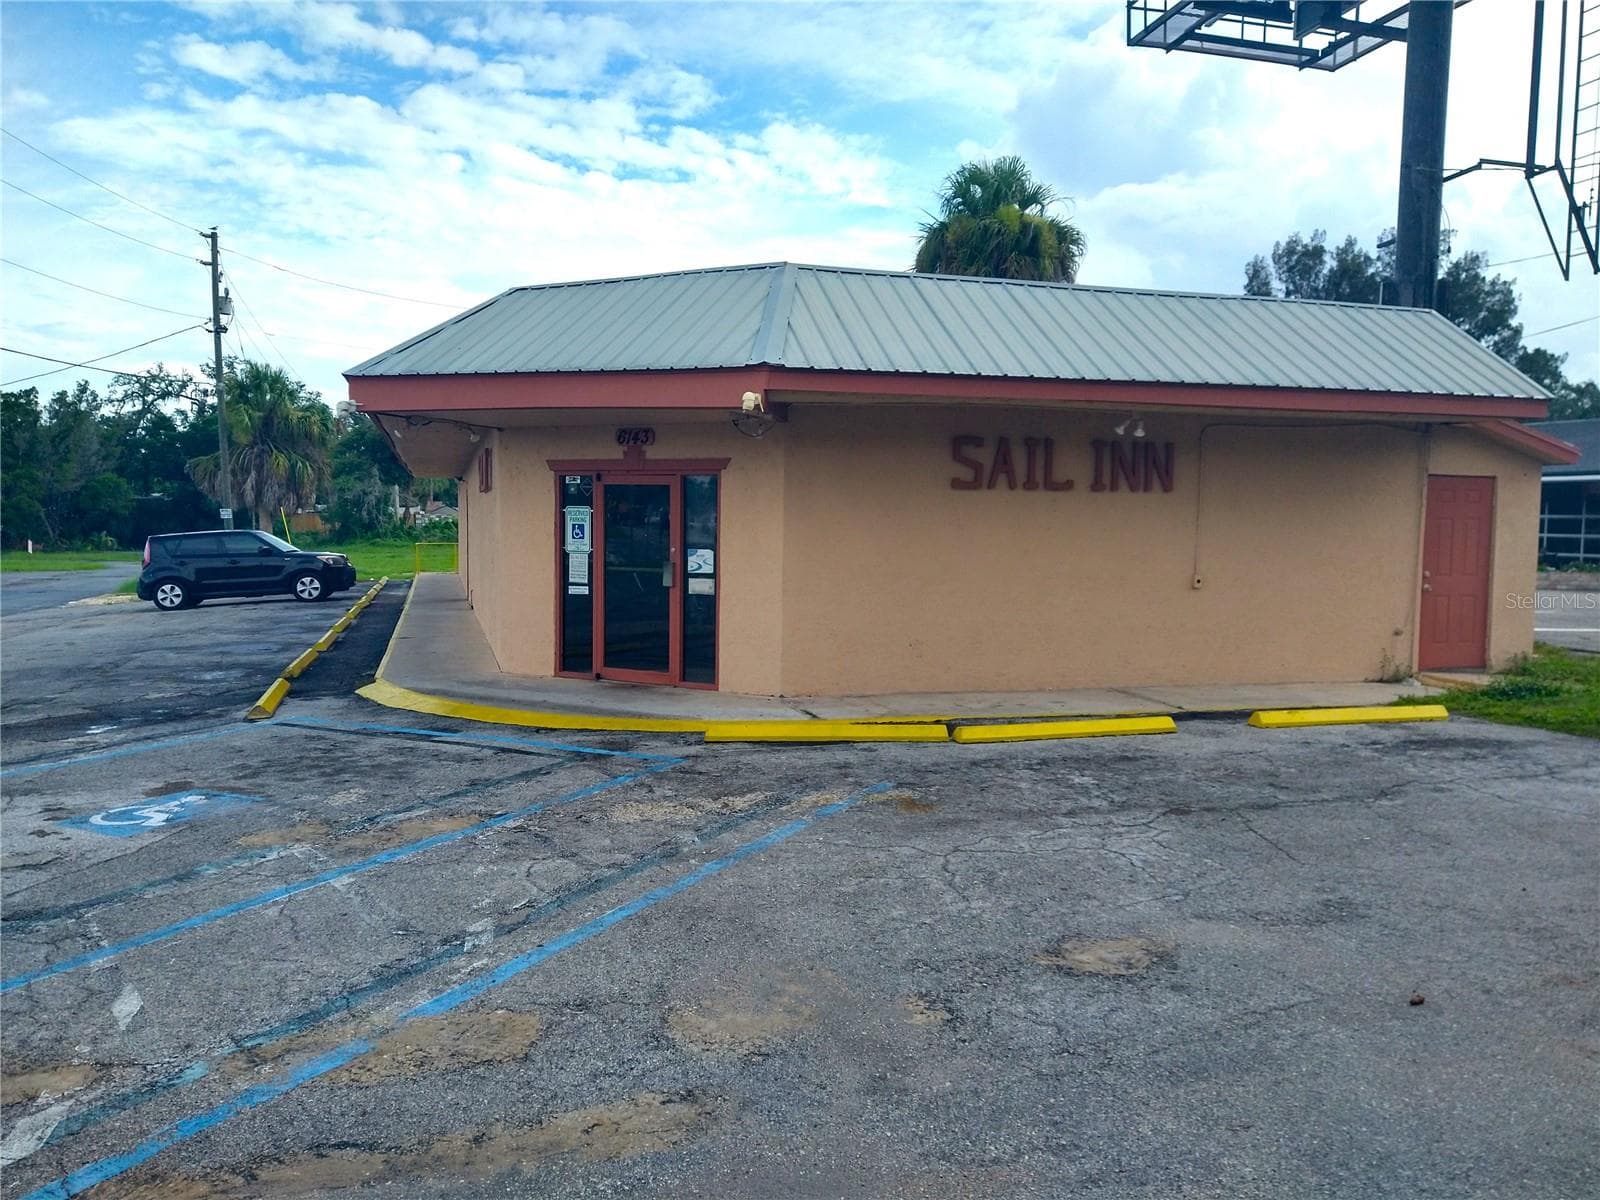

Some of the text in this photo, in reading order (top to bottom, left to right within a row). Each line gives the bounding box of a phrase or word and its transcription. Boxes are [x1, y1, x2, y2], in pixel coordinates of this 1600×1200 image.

[616, 428, 651, 445] 6143
[950, 435, 1175, 493] SAIL INN
